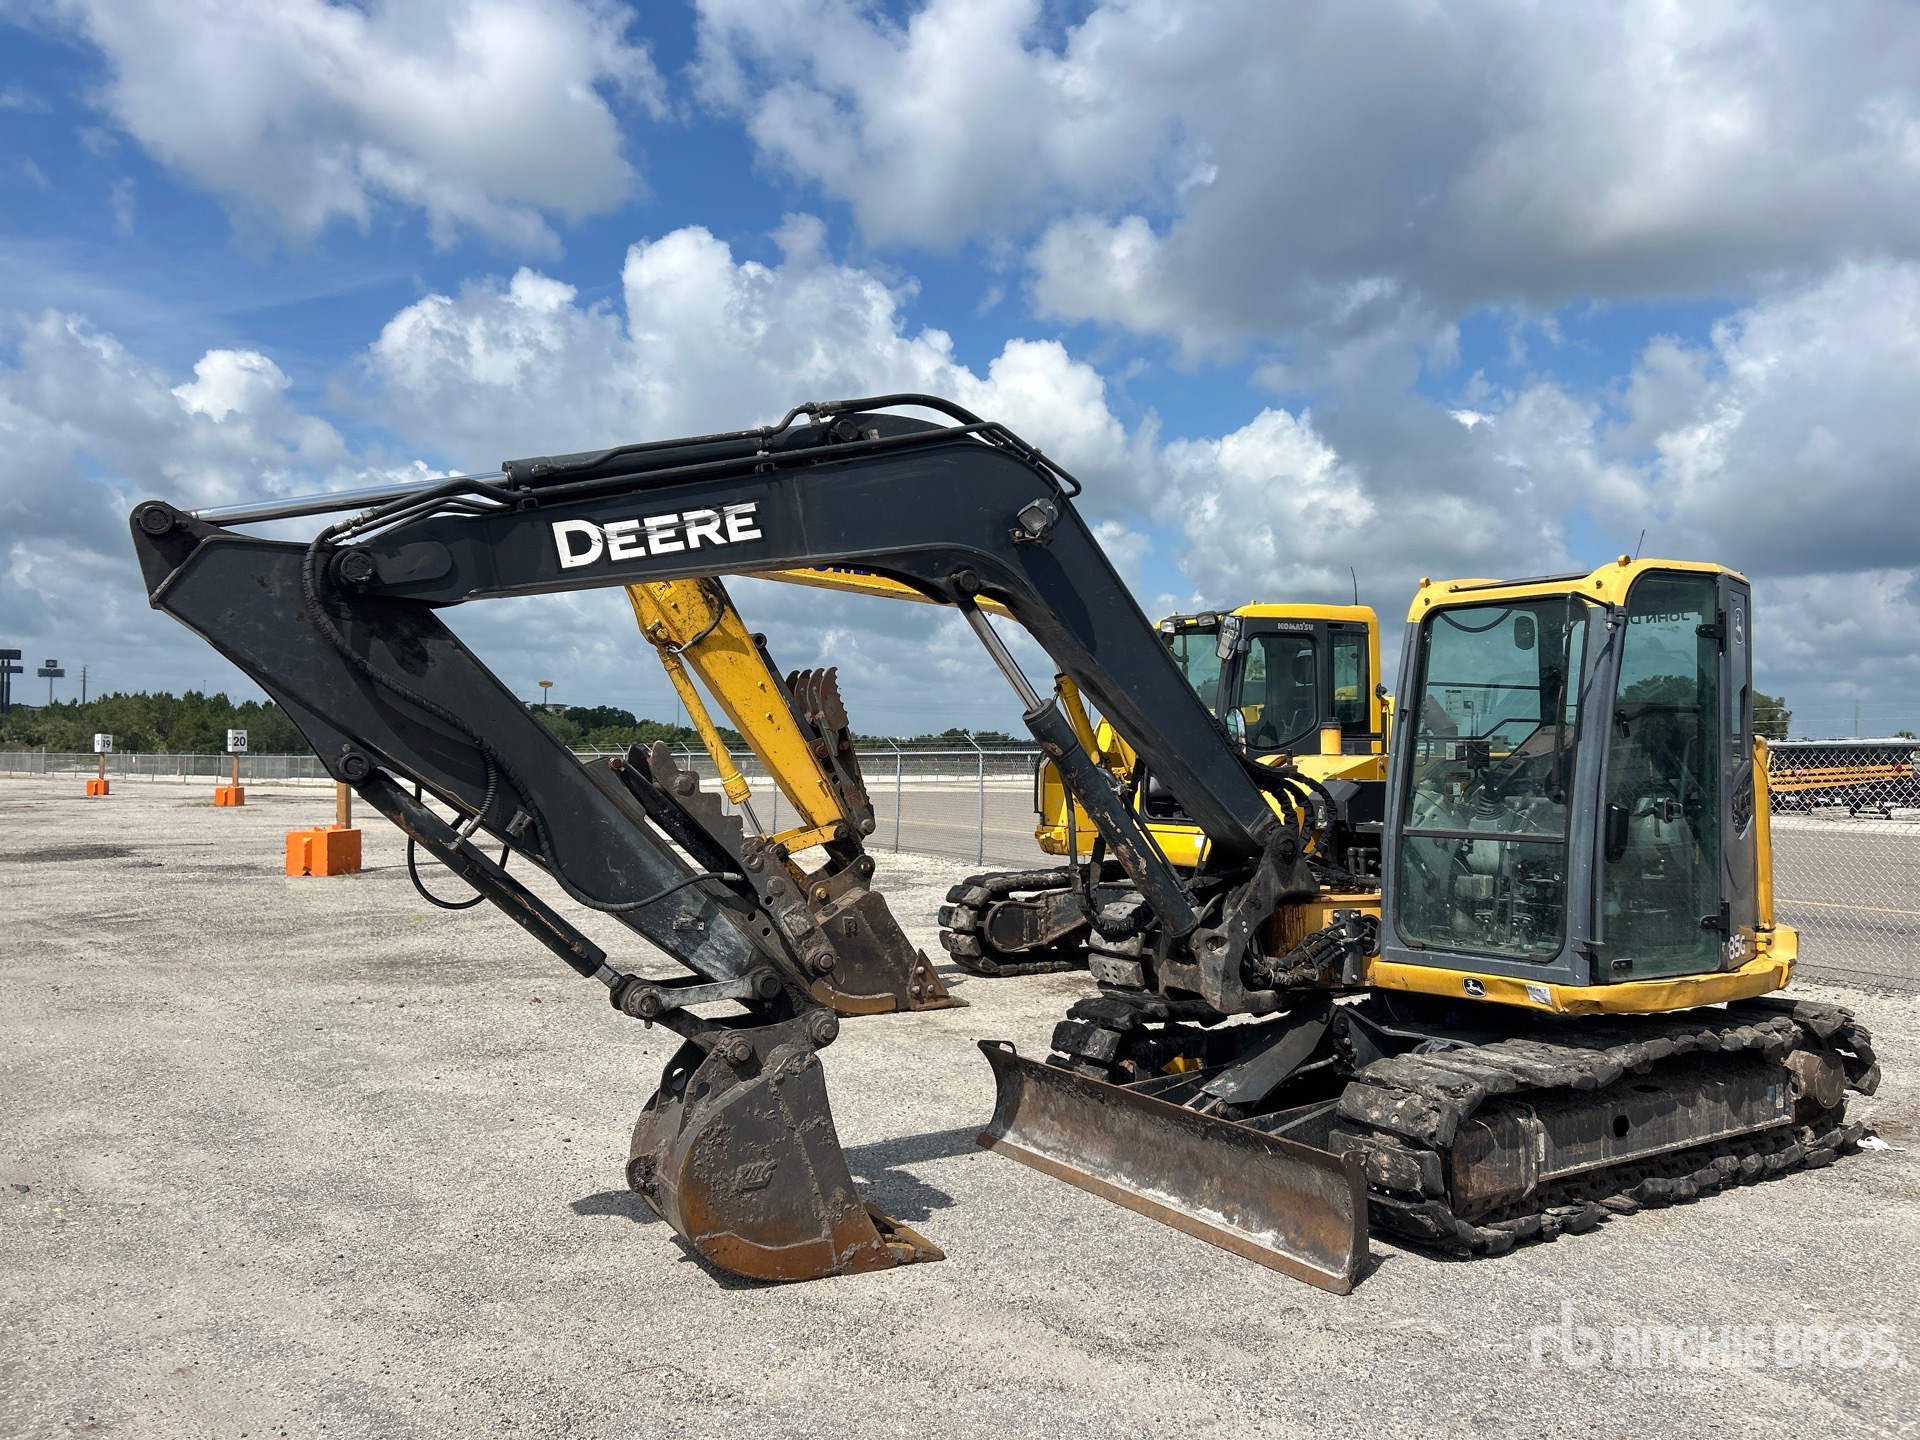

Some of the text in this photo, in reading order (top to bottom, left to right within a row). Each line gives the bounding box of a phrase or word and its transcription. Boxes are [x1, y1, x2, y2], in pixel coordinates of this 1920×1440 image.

[552, 500, 763, 569] DEERE
[1277, 621, 1314, 631] KOMATSU
[102, 739, 111, 749] 19
[233, 736, 246, 747] 20
[1728, 933, 1746, 960] 85G
